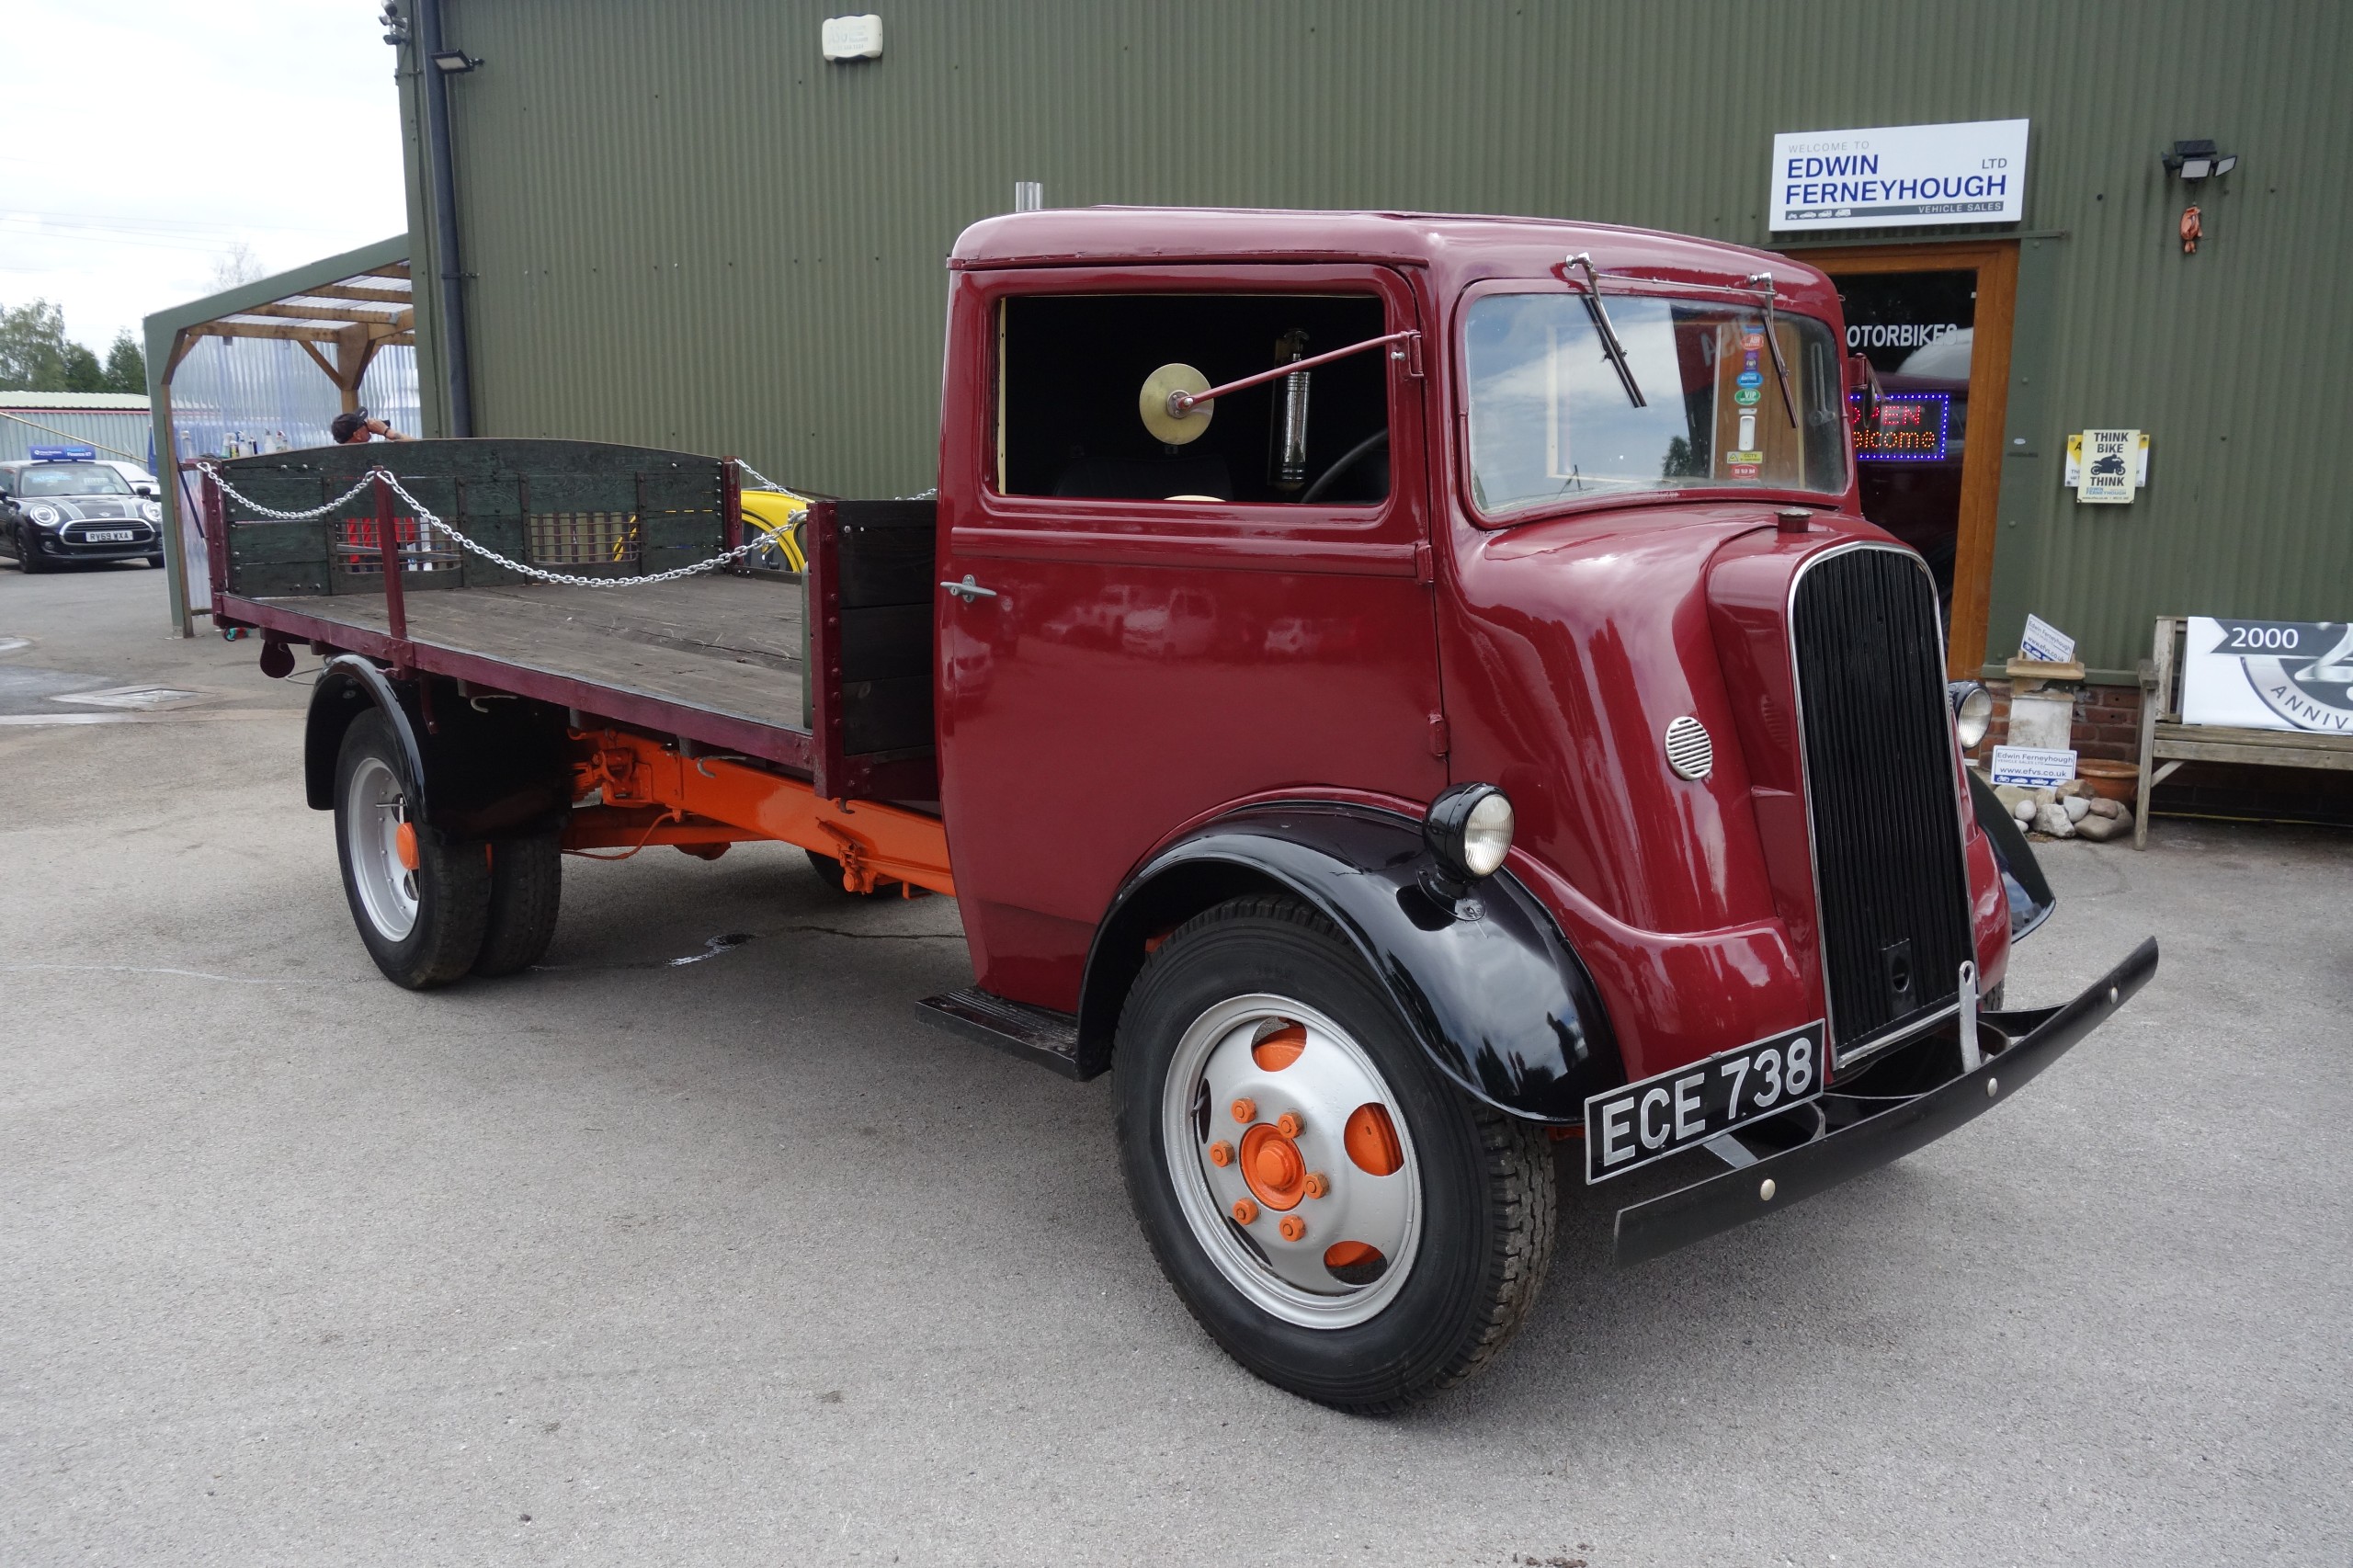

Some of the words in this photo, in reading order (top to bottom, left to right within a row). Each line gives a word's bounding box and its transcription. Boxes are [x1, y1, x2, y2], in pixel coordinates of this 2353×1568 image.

[1788, 142, 1848, 153] WELCOME
[1854, 141, 1870, 150] TO
[1788, 154, 1879, 179] EDWIN
[1982, 158, 2007, 169] LTD
[1786, 175, 2006, 205] FERNEYHOUGH
[1918, 204, 1963, 213] VEHICLE
[1967, 202, 2002, 211] SALES
[1844, 324, 1958, 347] OTORBIKES
[1853, 429, 1936, 449] elcome
[2094, 432, 2129, 442] THINK
[2097, 443, 2124, 453] BIKE
[2089, 476, 2125, 486] THINK
[2231, 627, 2299, 649] 2000
[2270, 686, 2348, 730] ANNIV
[1997, 752, 2020, 760] Edwin
[2022, 754, 2074, 765] Ferneyhough
[2000, 767, 2067, 778] www.efvs.co.uk
[1603, 1073, 1706, 1166] ECE
[1721, 1038, 1813, 1120] 738
